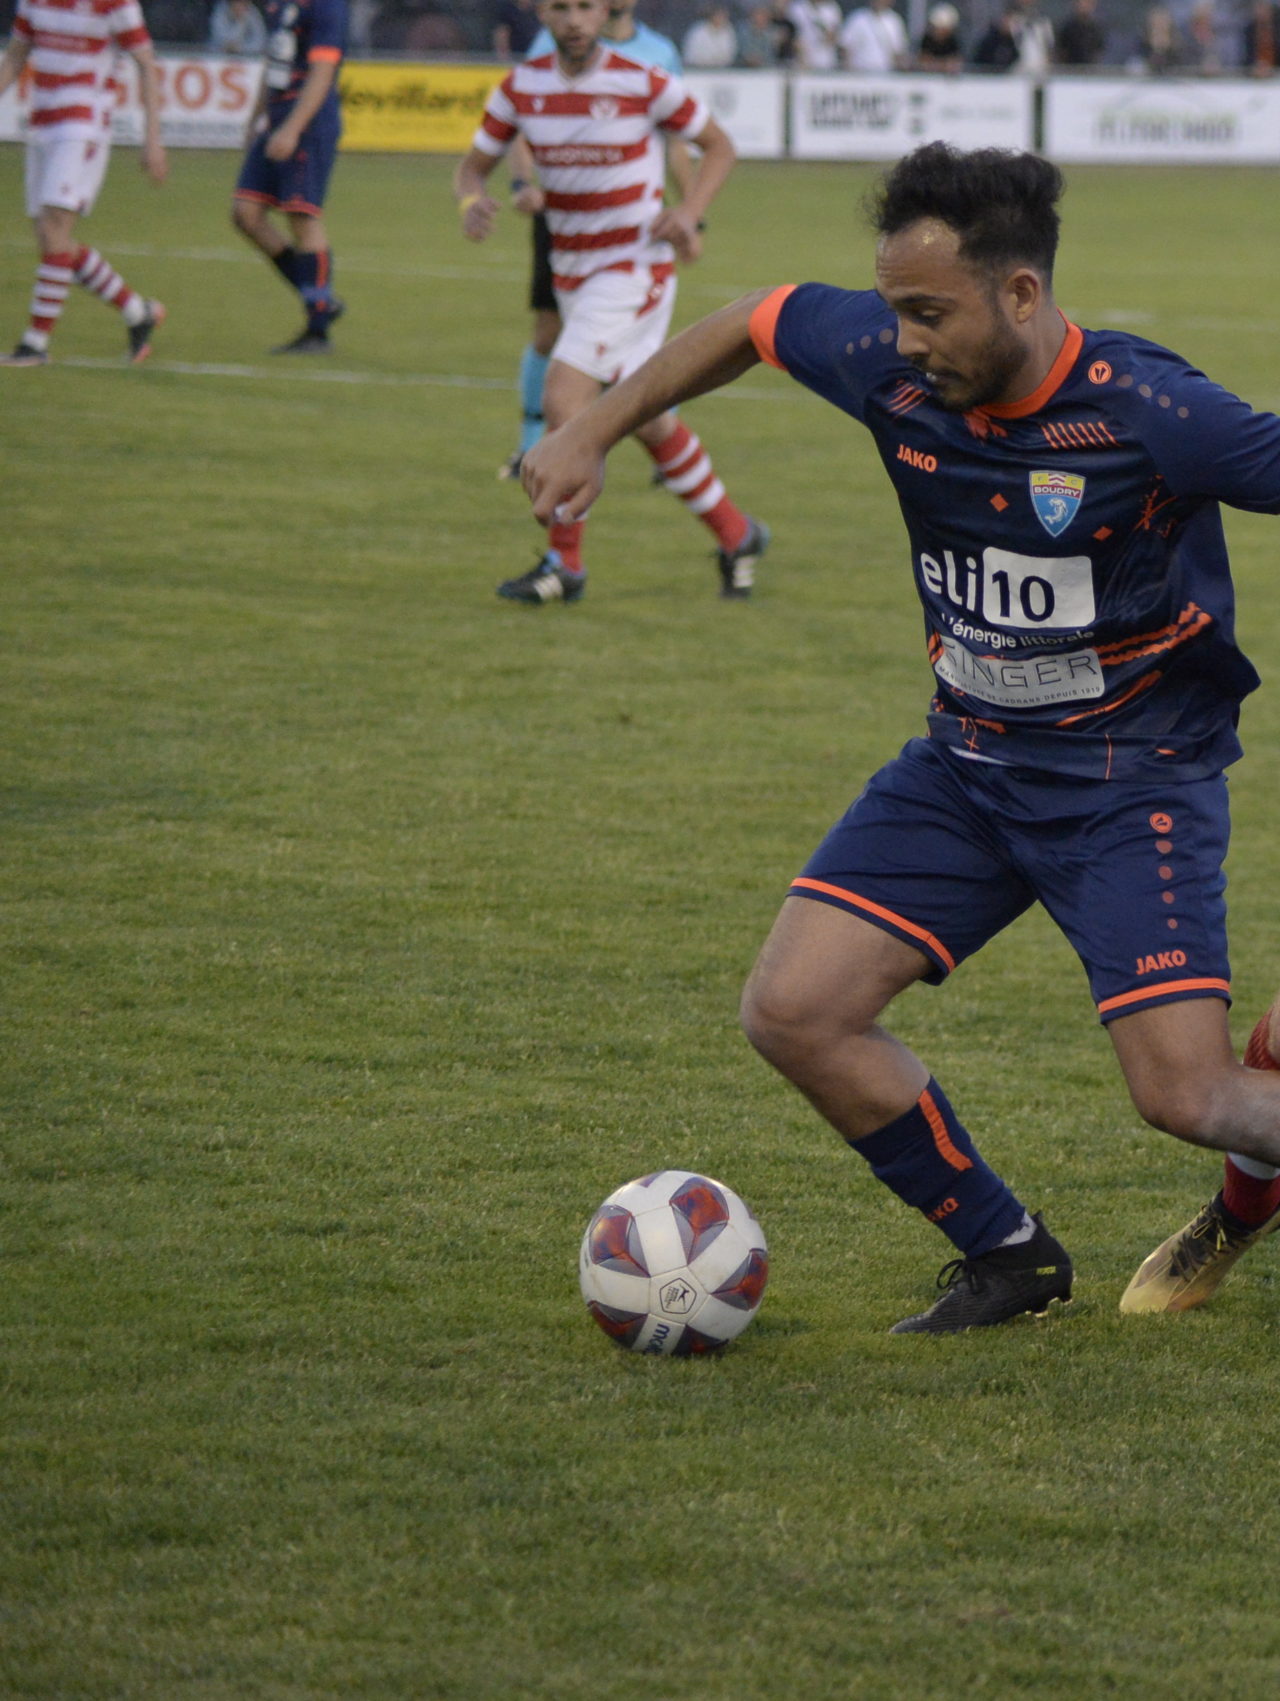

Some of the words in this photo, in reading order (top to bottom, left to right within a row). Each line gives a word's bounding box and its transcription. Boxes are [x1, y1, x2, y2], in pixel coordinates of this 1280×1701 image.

[897, 444, 938, 473] JAKO
[1034, 486, 1080, 497] BOUDRY
[941, 642, 1098, 689] SINGER
[1044, 689, 1078, 701] DEPUIS
[1135, 949, 1187, 976] JAKO
